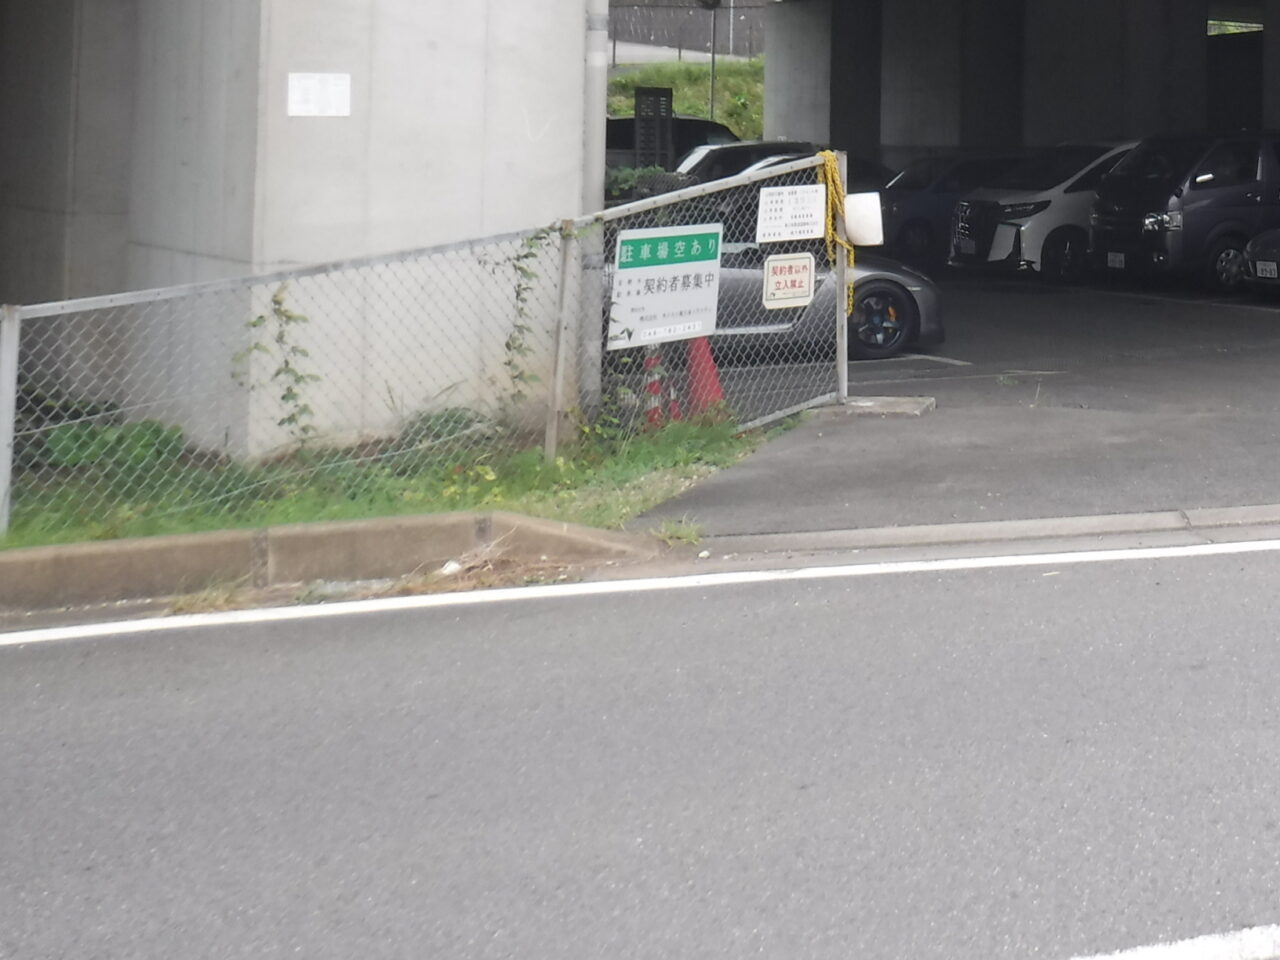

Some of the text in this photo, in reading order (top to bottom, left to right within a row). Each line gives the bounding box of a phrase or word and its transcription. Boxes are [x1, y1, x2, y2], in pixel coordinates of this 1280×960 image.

[620, 239, 716, 262] 駐車場空あり
[771, 264, 809, 277] 契約者以外
[643, 272, 715, 295] 契約者募集中
[775, 279, 805, 290] 立入禁止
